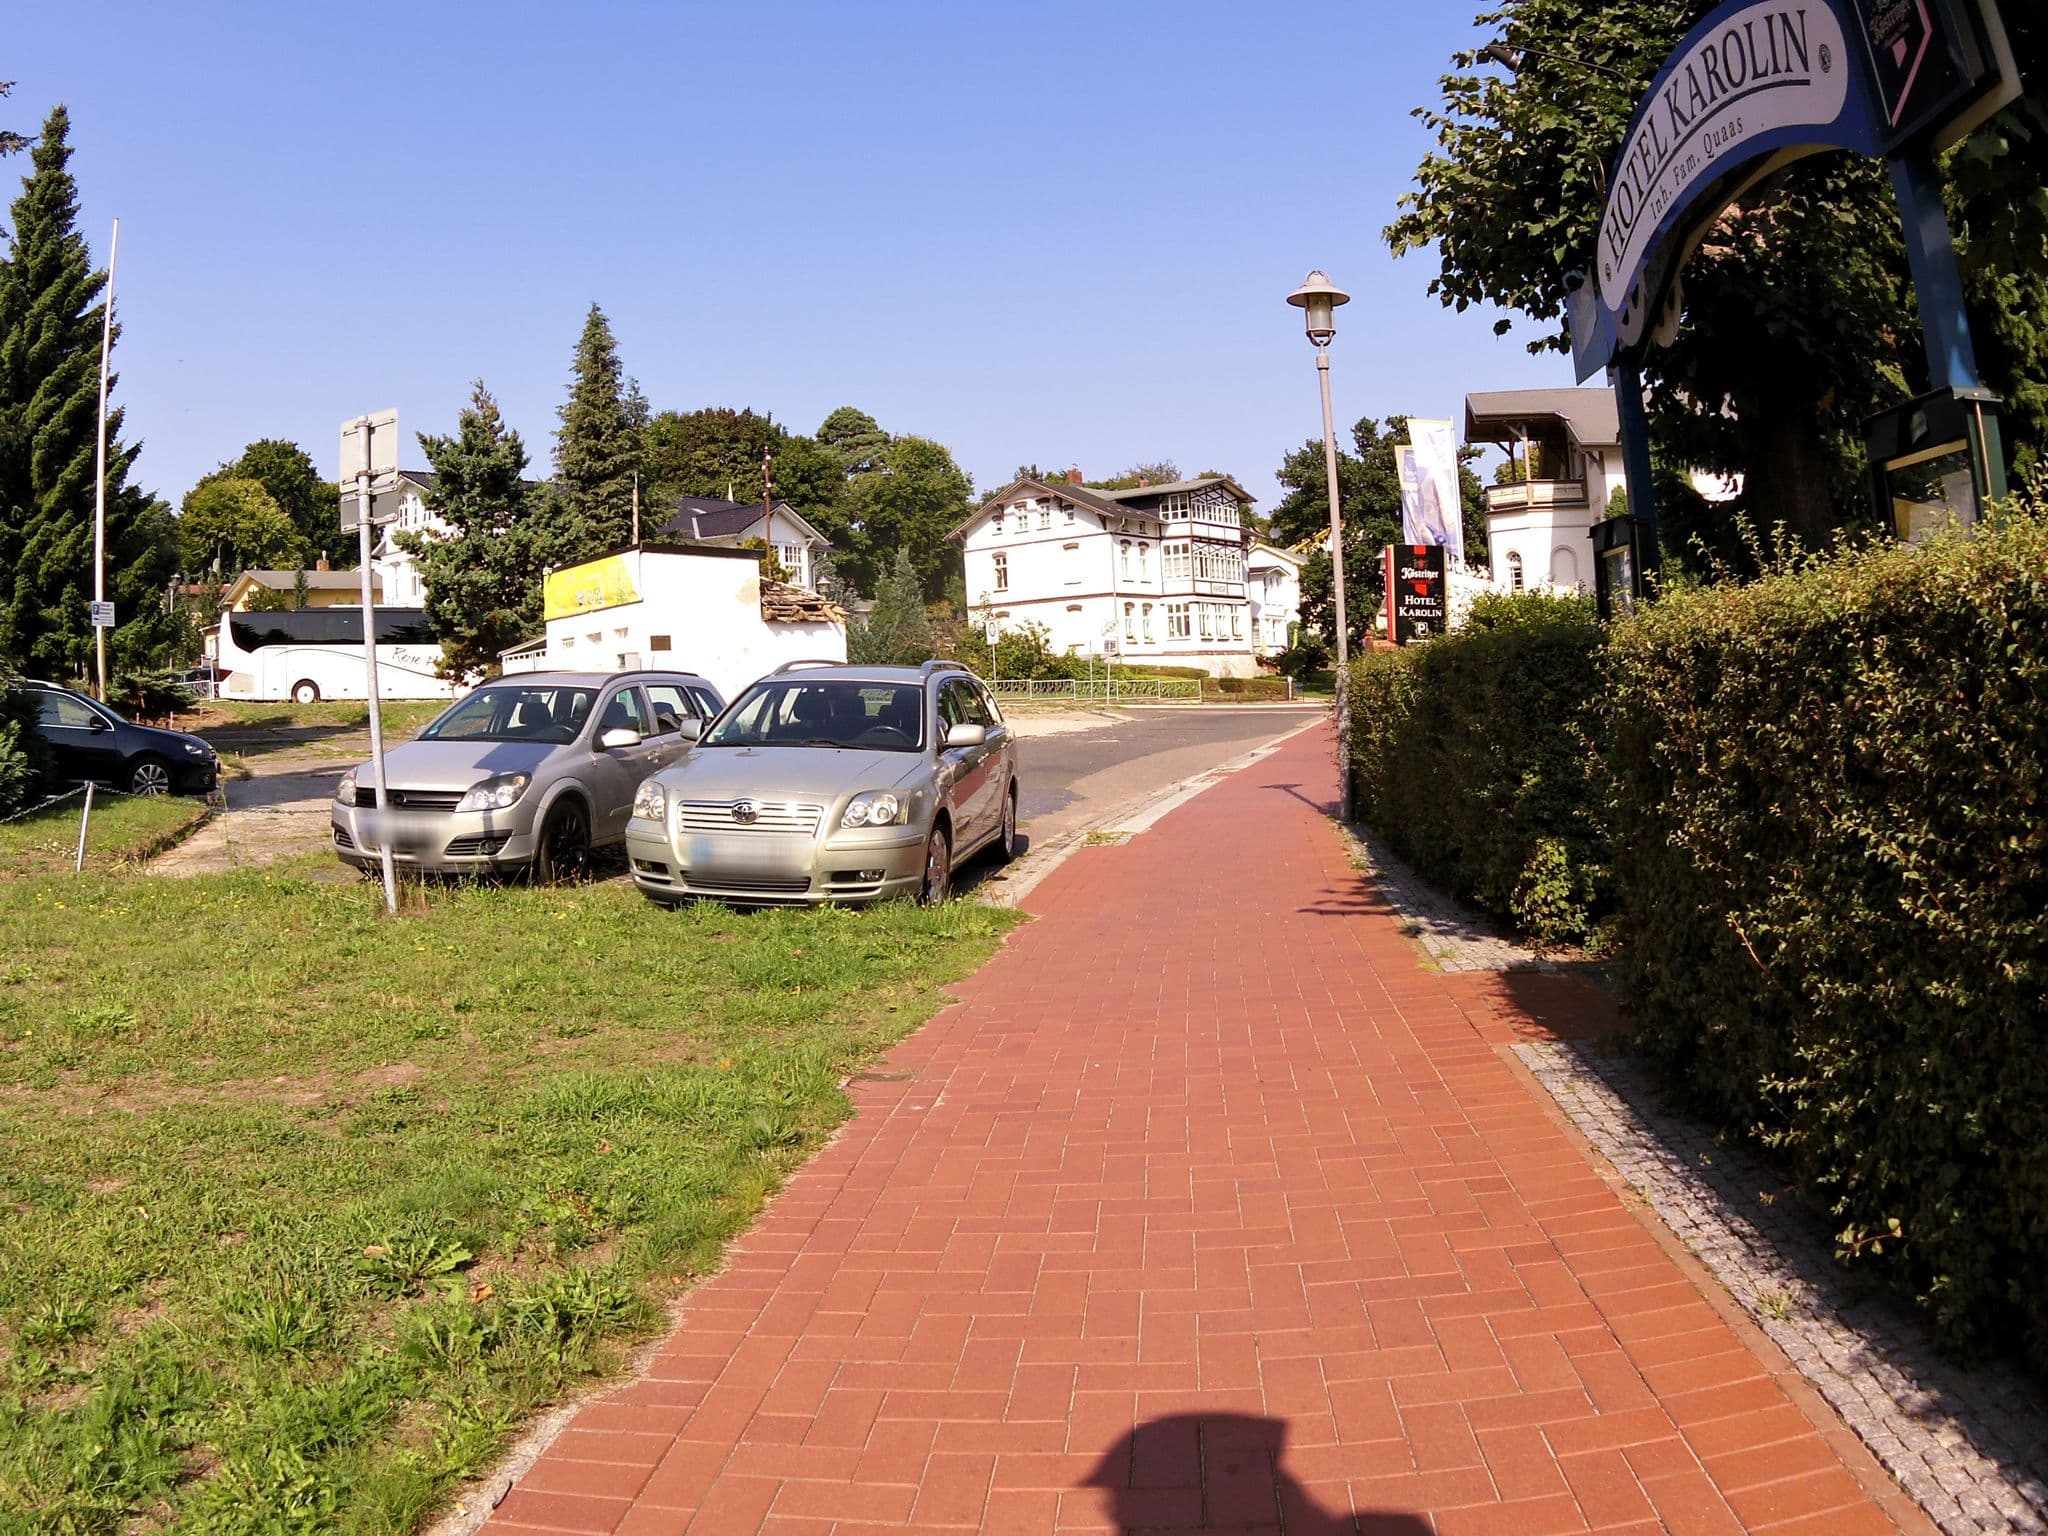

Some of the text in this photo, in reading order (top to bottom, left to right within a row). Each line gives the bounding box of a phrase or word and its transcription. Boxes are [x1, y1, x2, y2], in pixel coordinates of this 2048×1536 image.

[1604, 9, 1810, 267] HOTEL KAROLIN
[1650, 115, 1745, 220] Inh. Fam. Quaas
[1398, 606, 1442, 617] KAROLIN
[1404, 594, 1437, 606] HOTEL
